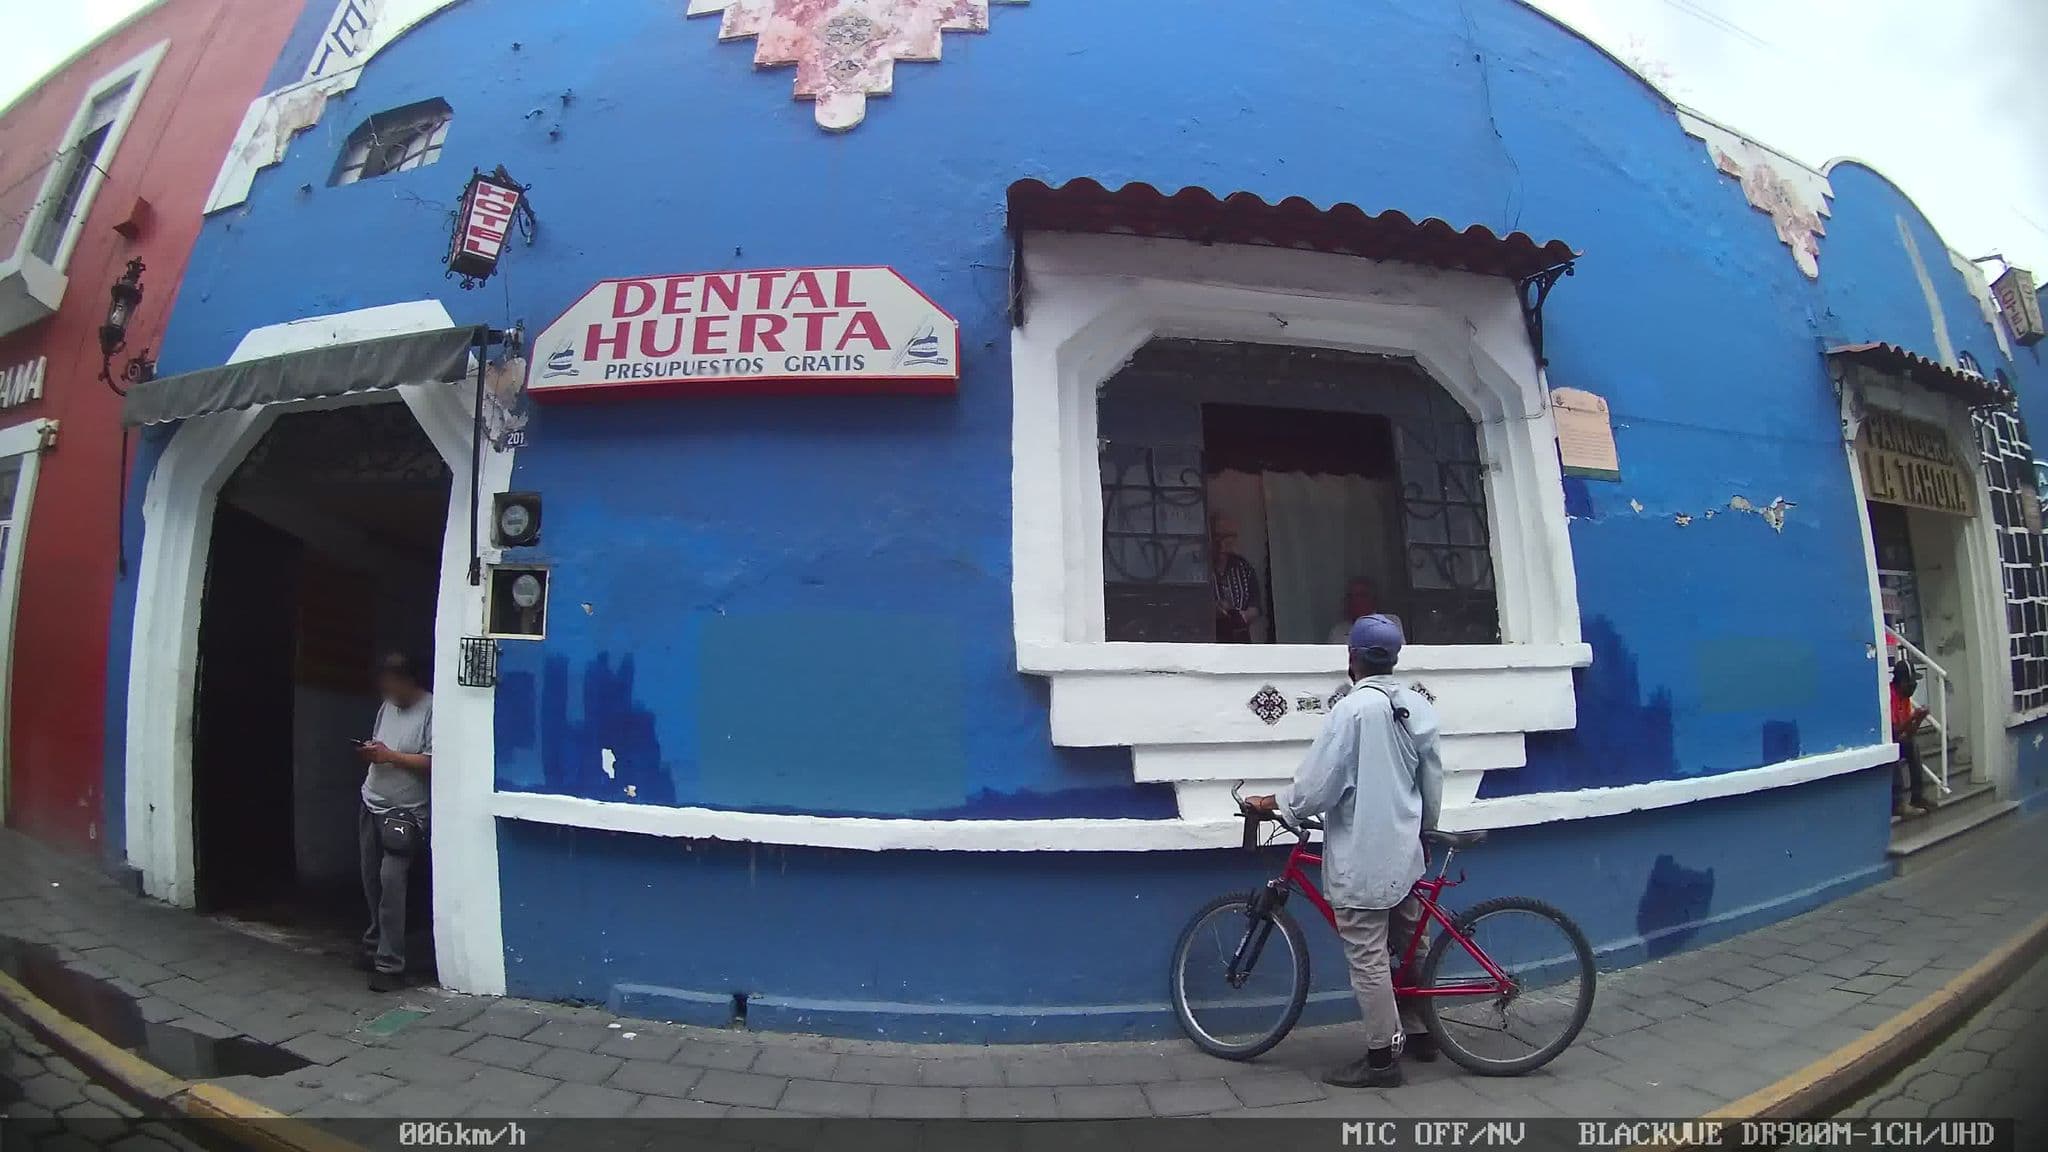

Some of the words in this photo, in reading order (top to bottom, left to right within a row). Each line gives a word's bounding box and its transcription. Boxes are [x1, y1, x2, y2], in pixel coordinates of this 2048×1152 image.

[462, 183, 517, 257] HOTEL
[611, 270, 868, 319] DENTAL
[583, 311, 892, 361] HUERTA
[604, 356, 764, 380] PRESUPUESTOS
[784, 354, 866, 373] GRATIS
[507, 432, 525, 445] 201
[1864, 451, 1894, 499] LA
